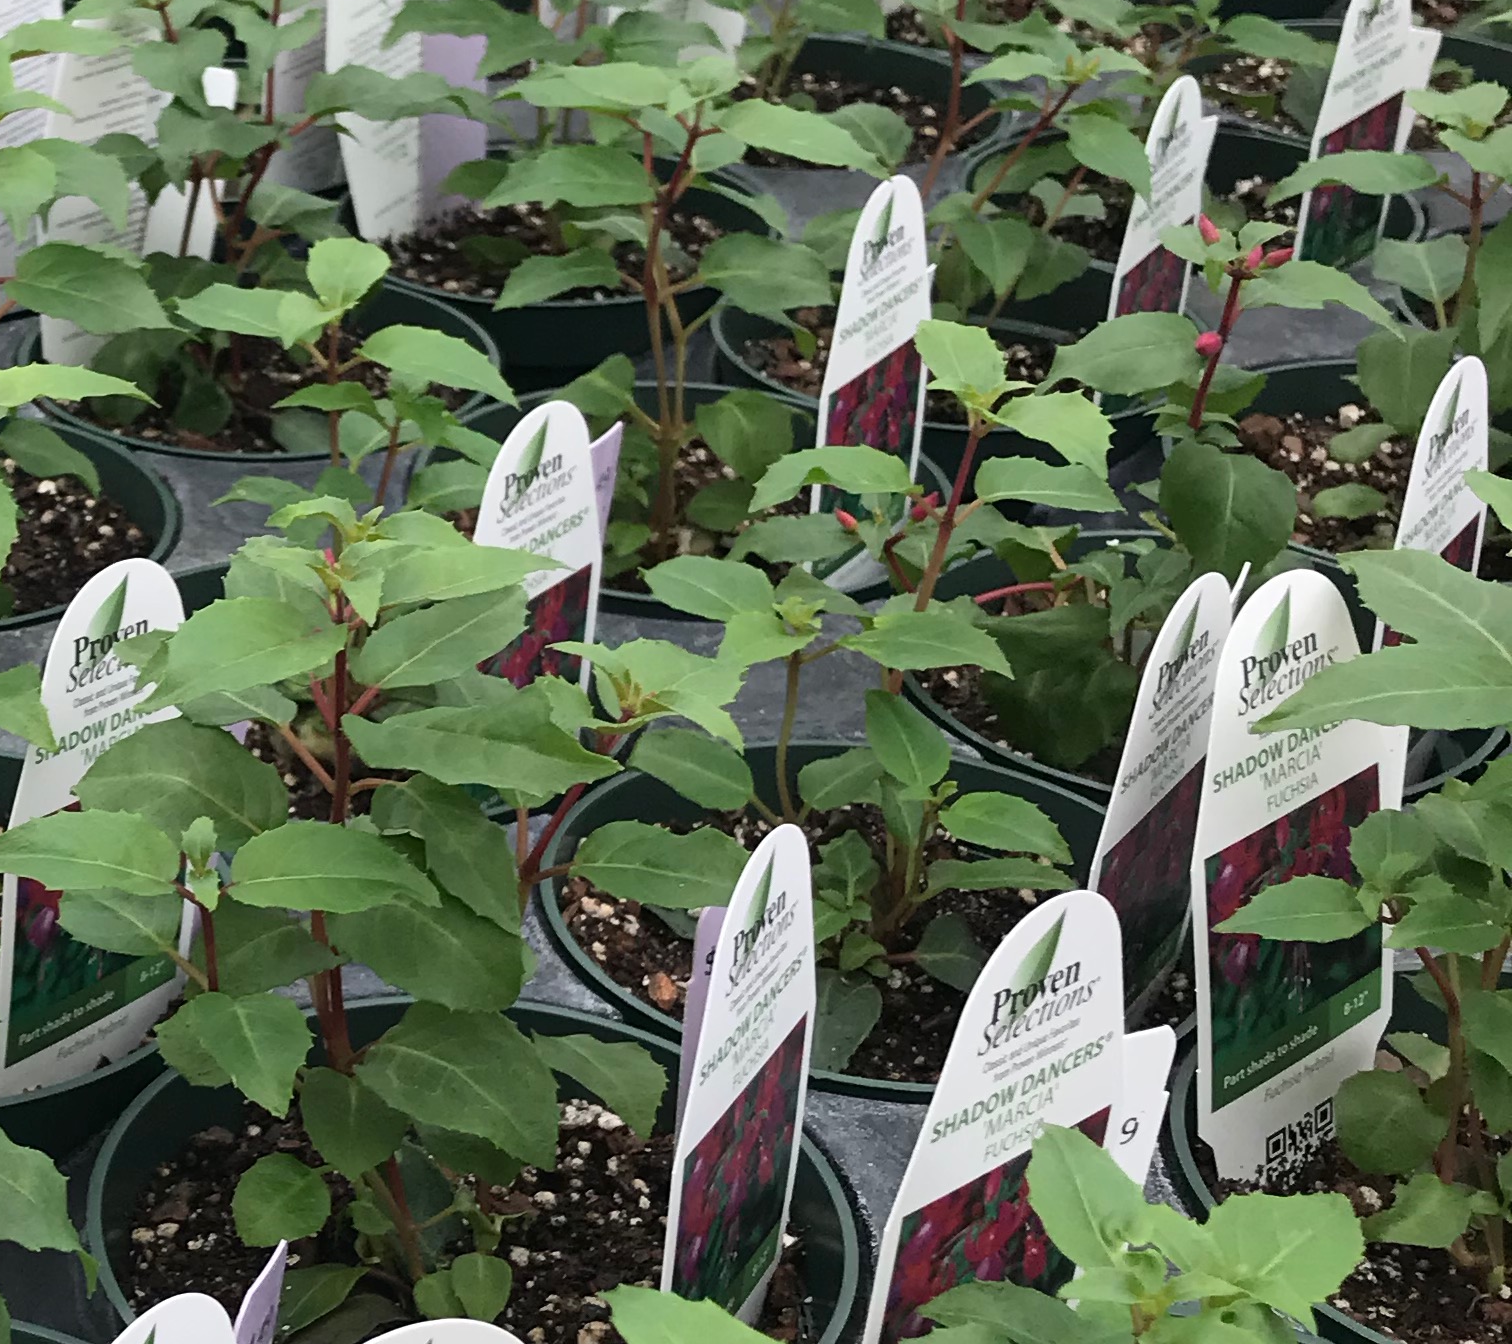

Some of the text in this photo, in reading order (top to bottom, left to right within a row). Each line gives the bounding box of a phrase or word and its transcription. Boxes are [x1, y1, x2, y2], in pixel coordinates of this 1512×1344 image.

[505, 453, 563, 501] Proven
[1157, 630, 1209, 693] Proven
[1240, 632, 1317, 688] Proven
[1121, 735, 1169, 795] SHADOW
[1213, 739, 1284, 793] SHADOW
[1266, 771, 1319, 812] FUCHSIA
[733, 891, 786, 966] Proven
[977, 980, 1095, 1056] Selections
[991, 961, 1080, 1026] Proven
[699, 1011, 752, 1087] SHADOW
[1224, 1025, 1318, 1089] Part shade to shade
[930, 1081, 1018, 1144] SHADOW
